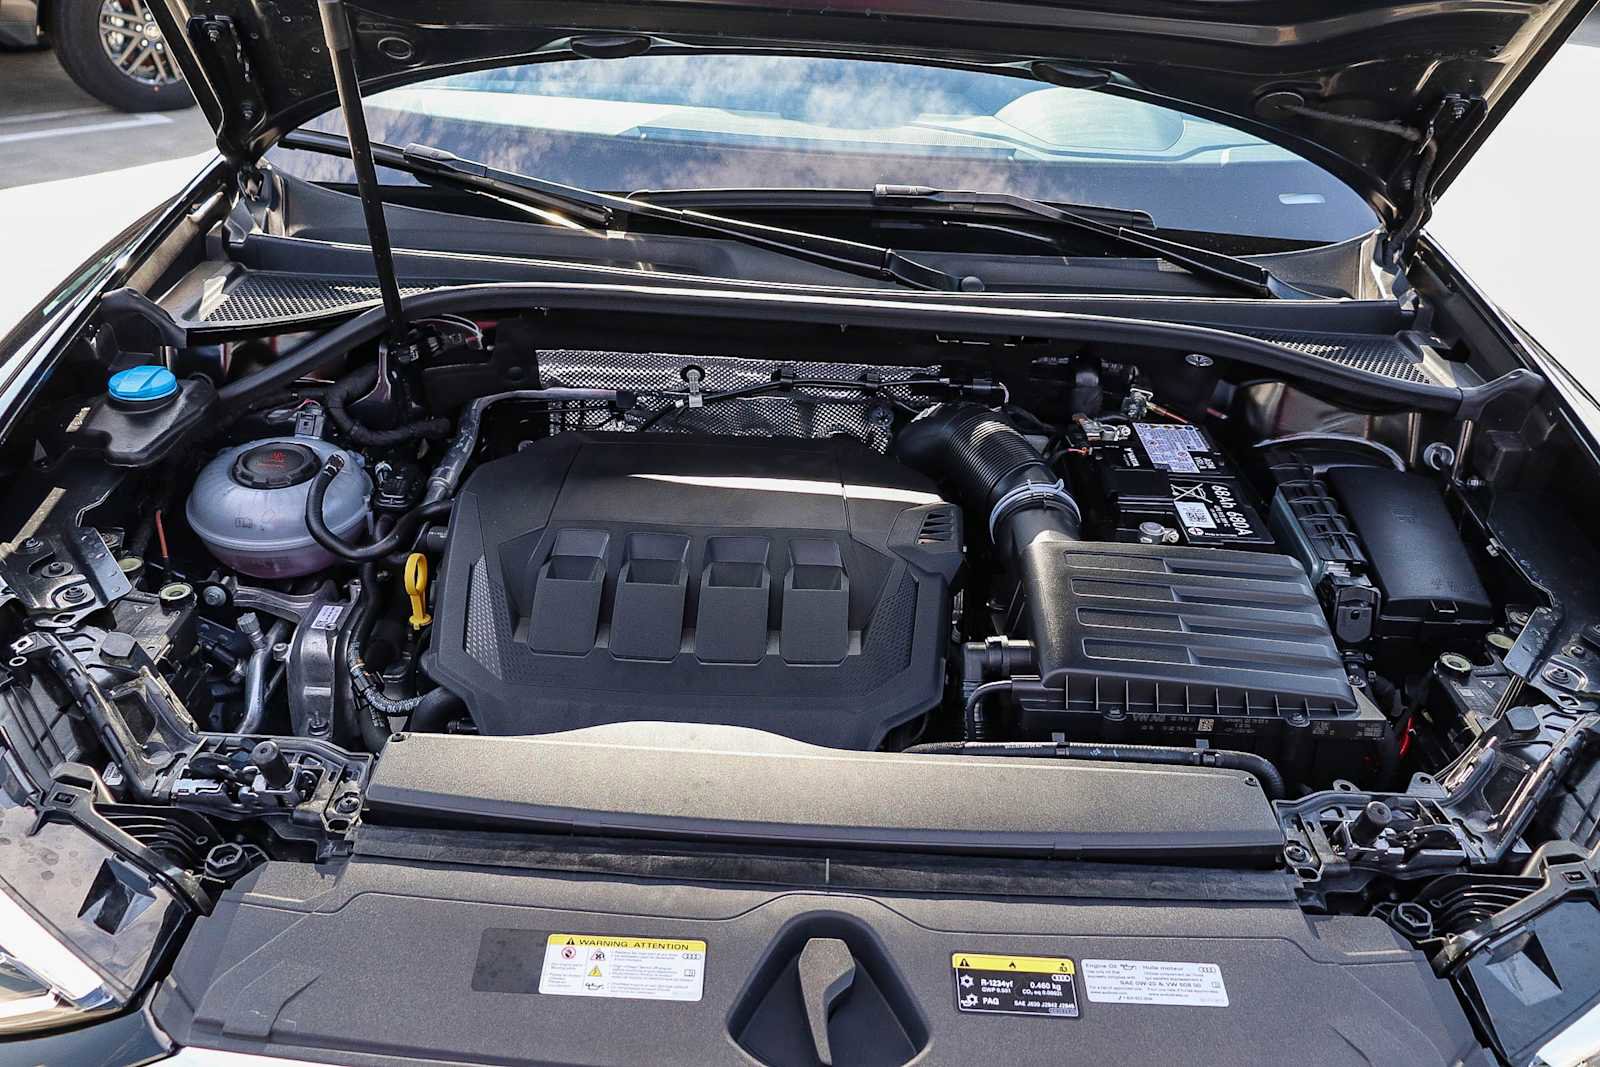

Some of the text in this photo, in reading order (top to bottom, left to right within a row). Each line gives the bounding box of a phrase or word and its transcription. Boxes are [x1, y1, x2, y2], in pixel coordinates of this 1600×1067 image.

[1211, 485, 1237, 509] 68Ah
[1226, 511, 1254, 535] 680A
[579, 939, 689, 950] WARNING ATTENTION
[980, 979, 1013, 988] R-1234yf
[1052, 982, 1061, 991] kg
[982, 997, 999, 1005] PAG
